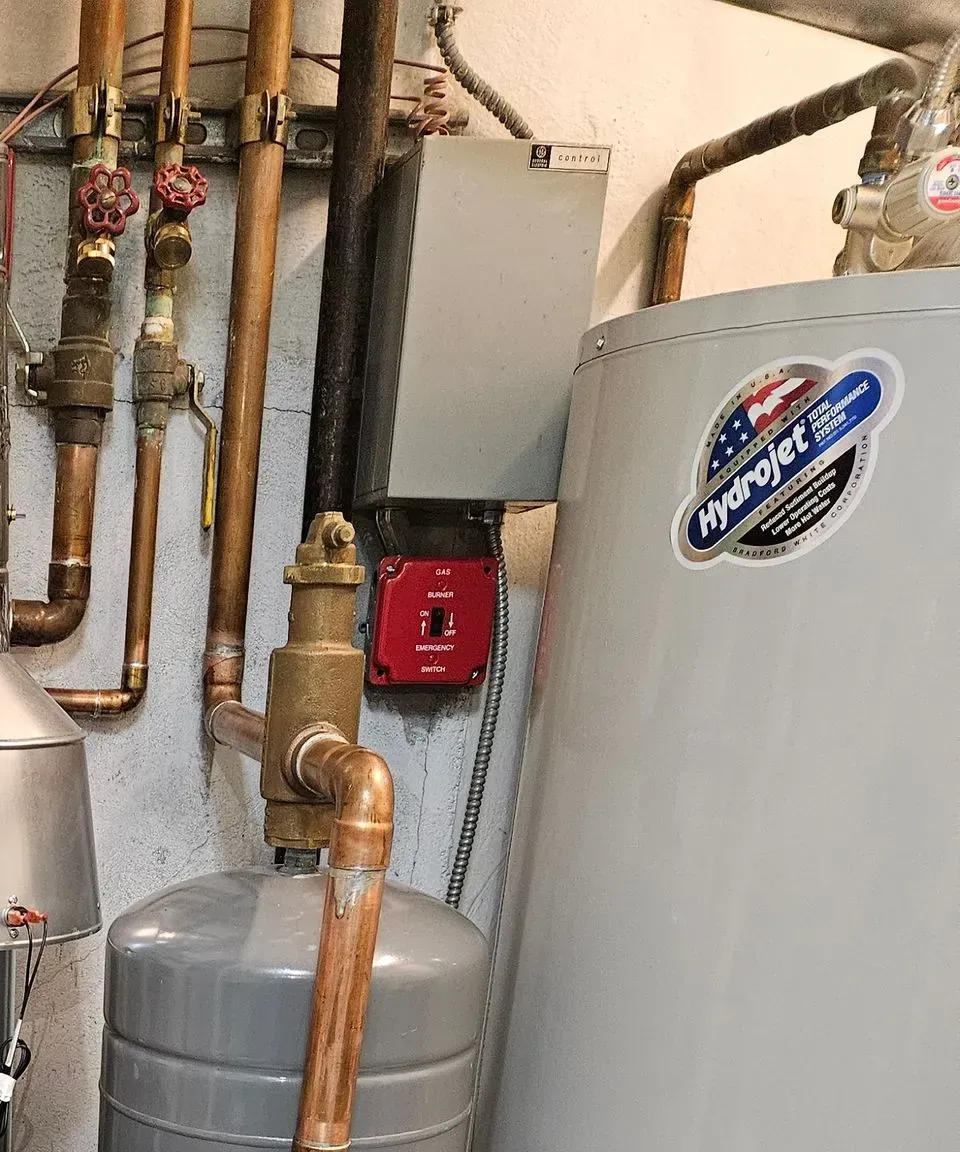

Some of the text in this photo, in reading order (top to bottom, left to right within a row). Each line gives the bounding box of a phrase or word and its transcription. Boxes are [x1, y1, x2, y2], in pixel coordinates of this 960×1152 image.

[706, 414, 725, 447] MADE
[731, 394, 742, 404] IN
[807, 400, 832, 423] TOTAL
[811, 380, 870, 432] PERFORMANCE
[814, 413, 847, 442] SYSTEM
[719, 429, 774, 480] EQUIPPED
[781, 396, 811, 423] WITH
[732, 434, 869, 557] BRADFORD WHITE CORPORATION
[758, 460, 825, 516] FEATURING
[760, 469, 837, 532] Reduced Sediment Buildup
[771, 483, 836, 536] Lower Operating Costs
[785, 498, 831, 536] More Hot Water
